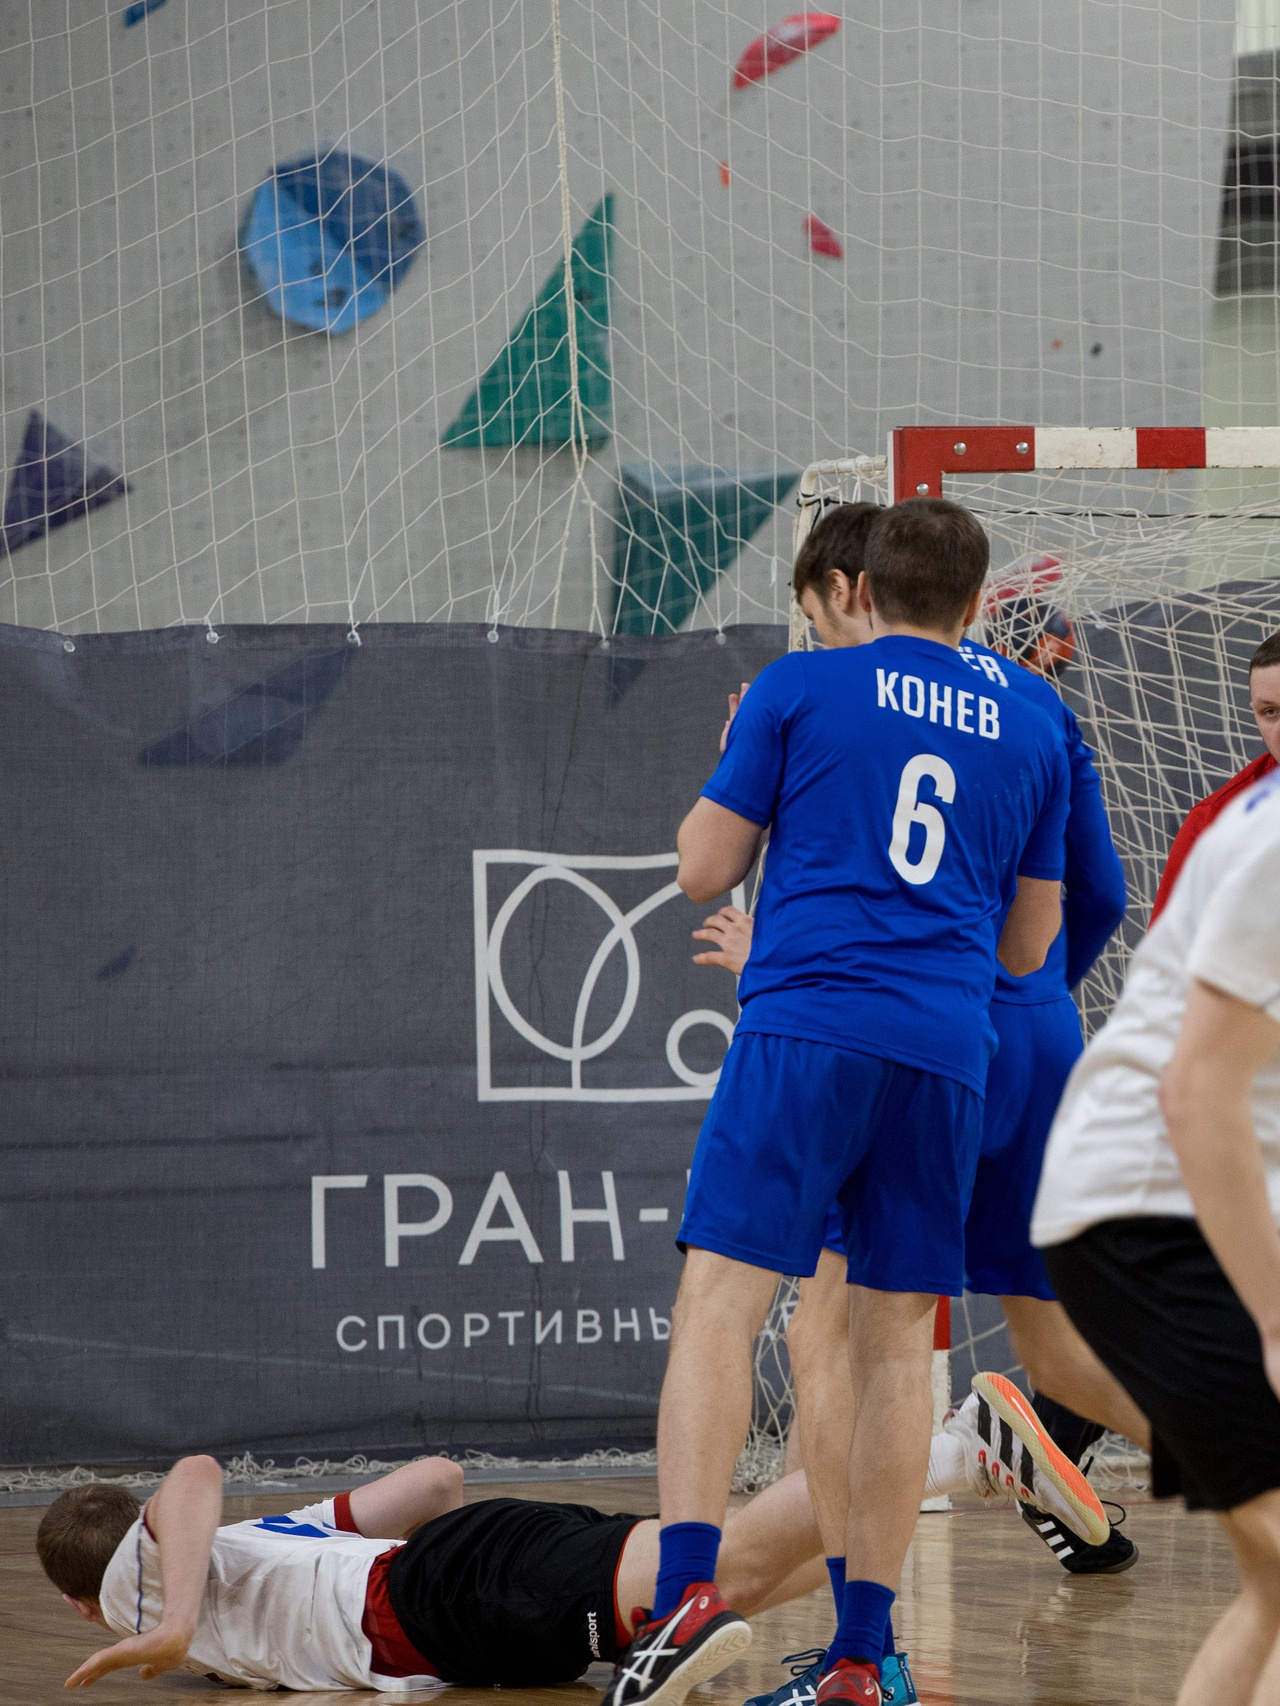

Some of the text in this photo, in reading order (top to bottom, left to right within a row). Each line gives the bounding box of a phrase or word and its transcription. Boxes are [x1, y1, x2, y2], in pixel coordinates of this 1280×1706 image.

[957, 645, 1009, 688] ЁВ
[876, 667, 1000, 740] КОНЕВ
[888, 753, 957, 885] 6
[311, 1168, 692, 1270] ГРАН-
[336, 1306, 675, 1352] СПОРТИВНЫ
